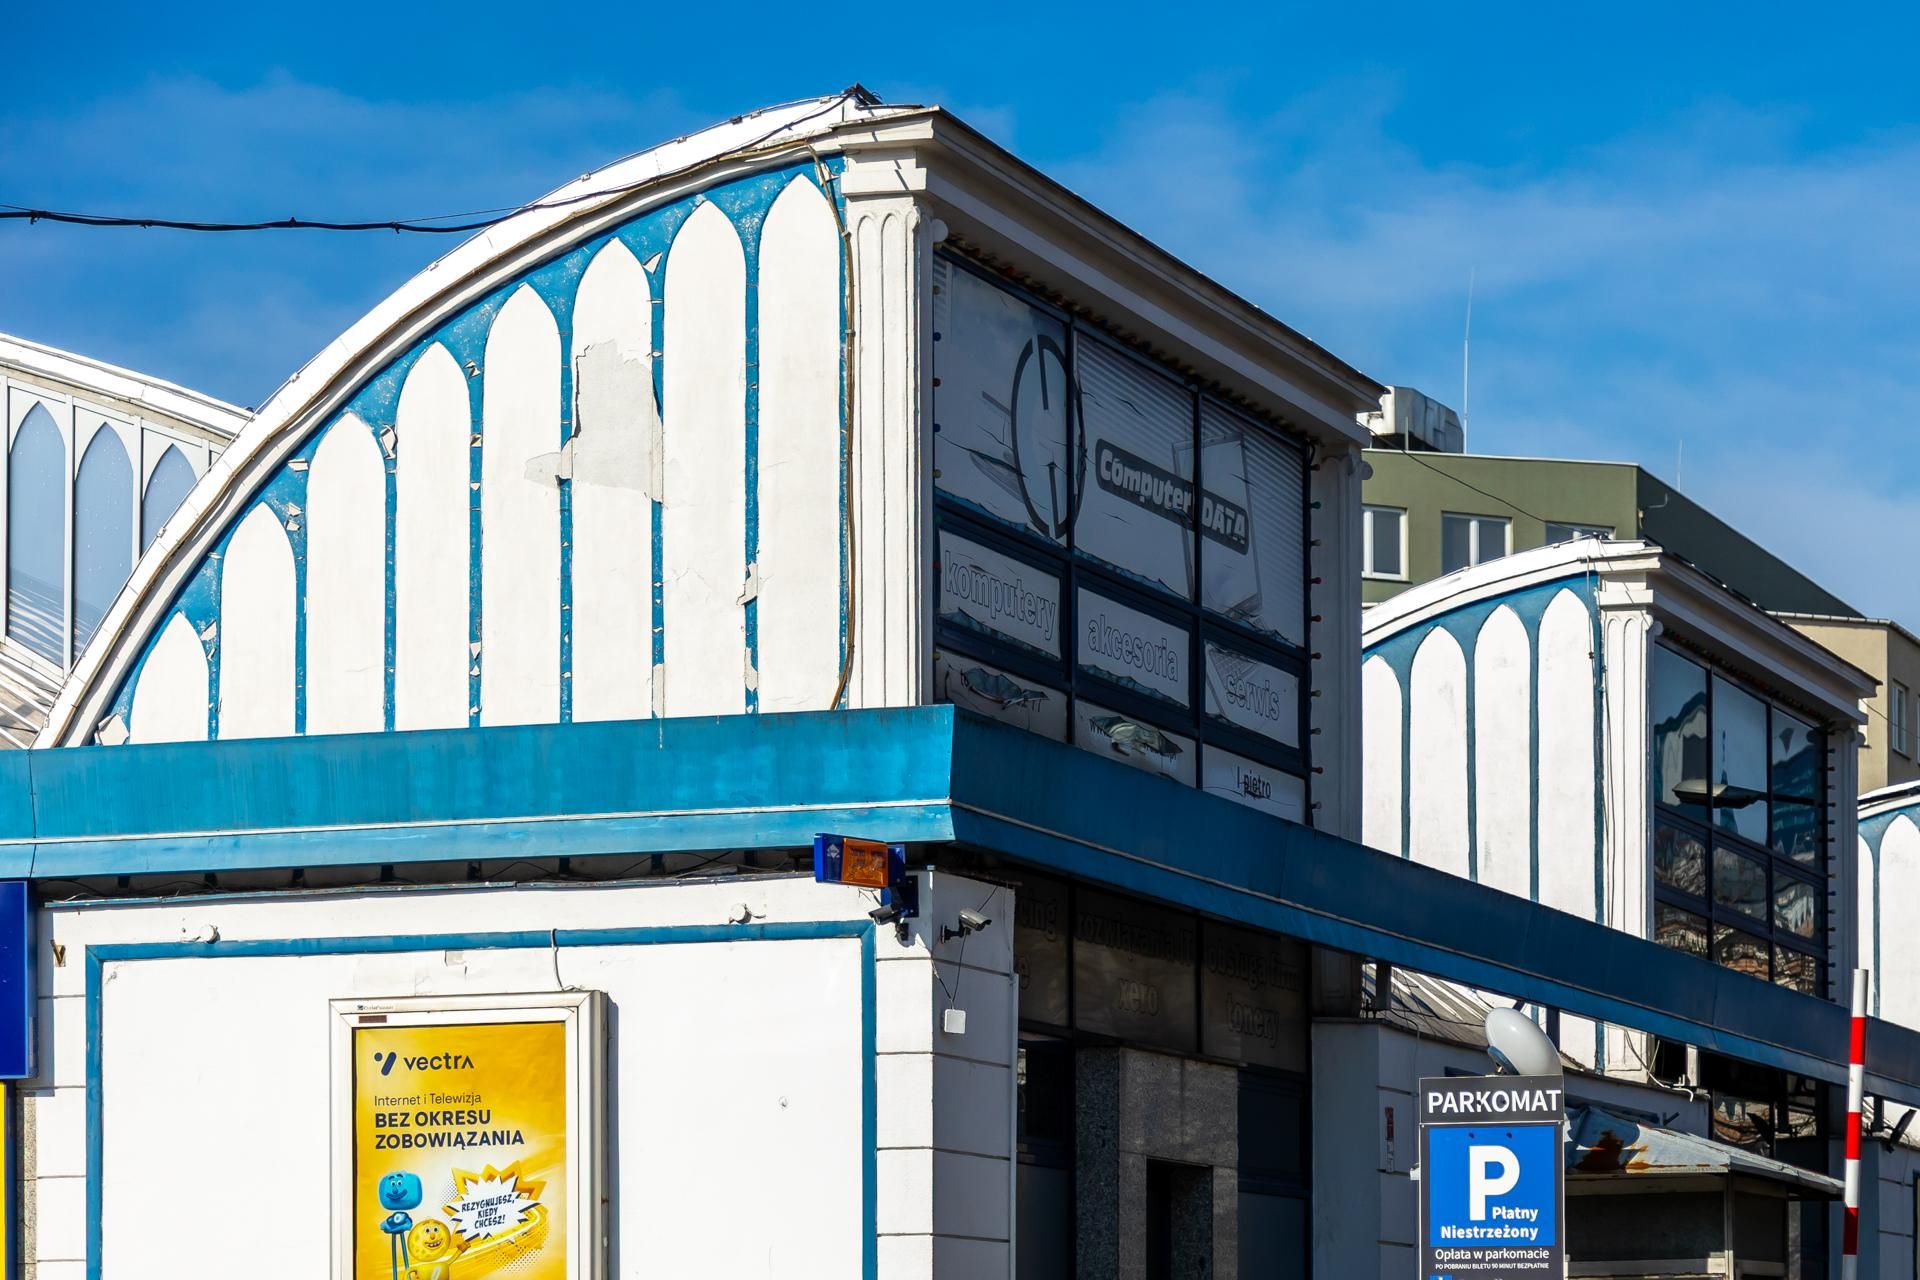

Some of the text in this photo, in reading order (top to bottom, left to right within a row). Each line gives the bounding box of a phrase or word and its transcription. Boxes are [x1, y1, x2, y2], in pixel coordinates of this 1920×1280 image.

[1100, 448, 1246, 545] Computer DATA
[943, 550, 1056, 640] komputery
[1087, 614, 1179, 682] akcesoria
[1225, 673, 1280, 721] serwis
[1118, 978, 1160, 1017] xero
[1226, 991, 1280, 1049] tonery
[374, 1092, 482, 1107] Internet i Telewizja
[1428, 1089, 1562, 1114] PARKOMAT
[375, 1109, 491, 1128] BEZ OKRESU
[375, 1130, 525, 1150] ZOBOWIĄZANIA
[1469, 1145, 1521, 1221] P
[461, 1193, 515, 1213] REZYGNUJESZ,
[477, 1207, 499, 1219] KIEDY
[474, 1214, 506, 1229] CHCESZ!
[1491, 1206, 1539, 1222] Płatny
[1440, 1224, 1539, 1241] Niestrzeżony
[1435, 1247, 1550, 1262] Opłata w parkomacie
[1499, 1262, 1516, 1270] MINUT
